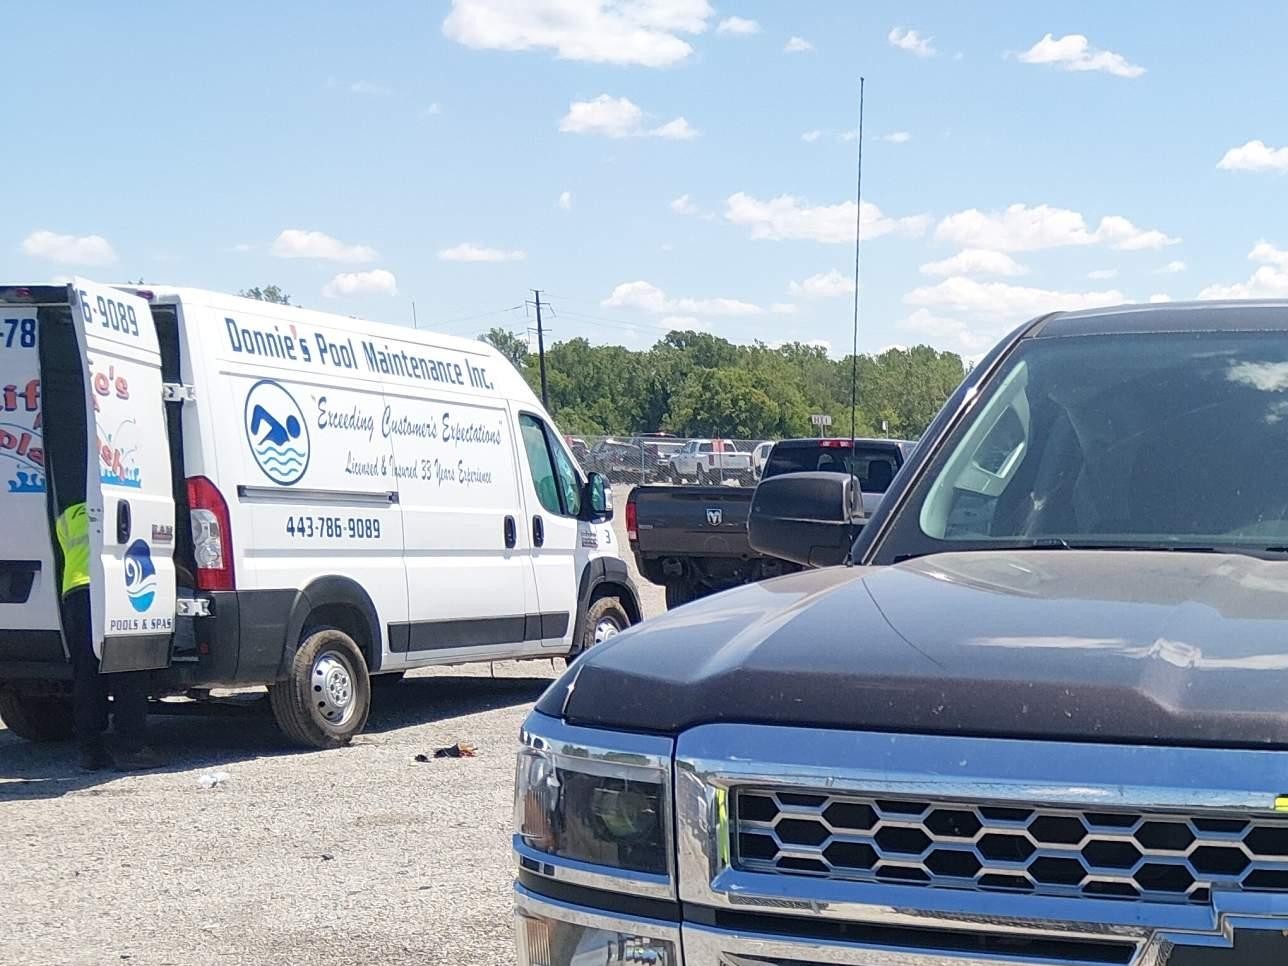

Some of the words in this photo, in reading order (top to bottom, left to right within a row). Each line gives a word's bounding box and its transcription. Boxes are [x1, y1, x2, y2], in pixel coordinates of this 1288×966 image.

[224, 317, 312, 363] Donnie's
[314, 332, 358, 370] Pool
[361, 340, 463, 385] Maintenance
[465, 358, 495, 391] Inc.
[345, 450, 379, 477] Licensed
[381, 455, 387, 476] &
[421, 459, 432, 480] 33
[434, 458, 455, 486] Years
[458, 459, 493, 487] Experience
[111, 619, 138, 631] POOLS
[142, 618, 148, 630] &
[151, 618, 172, 630] SPAS
